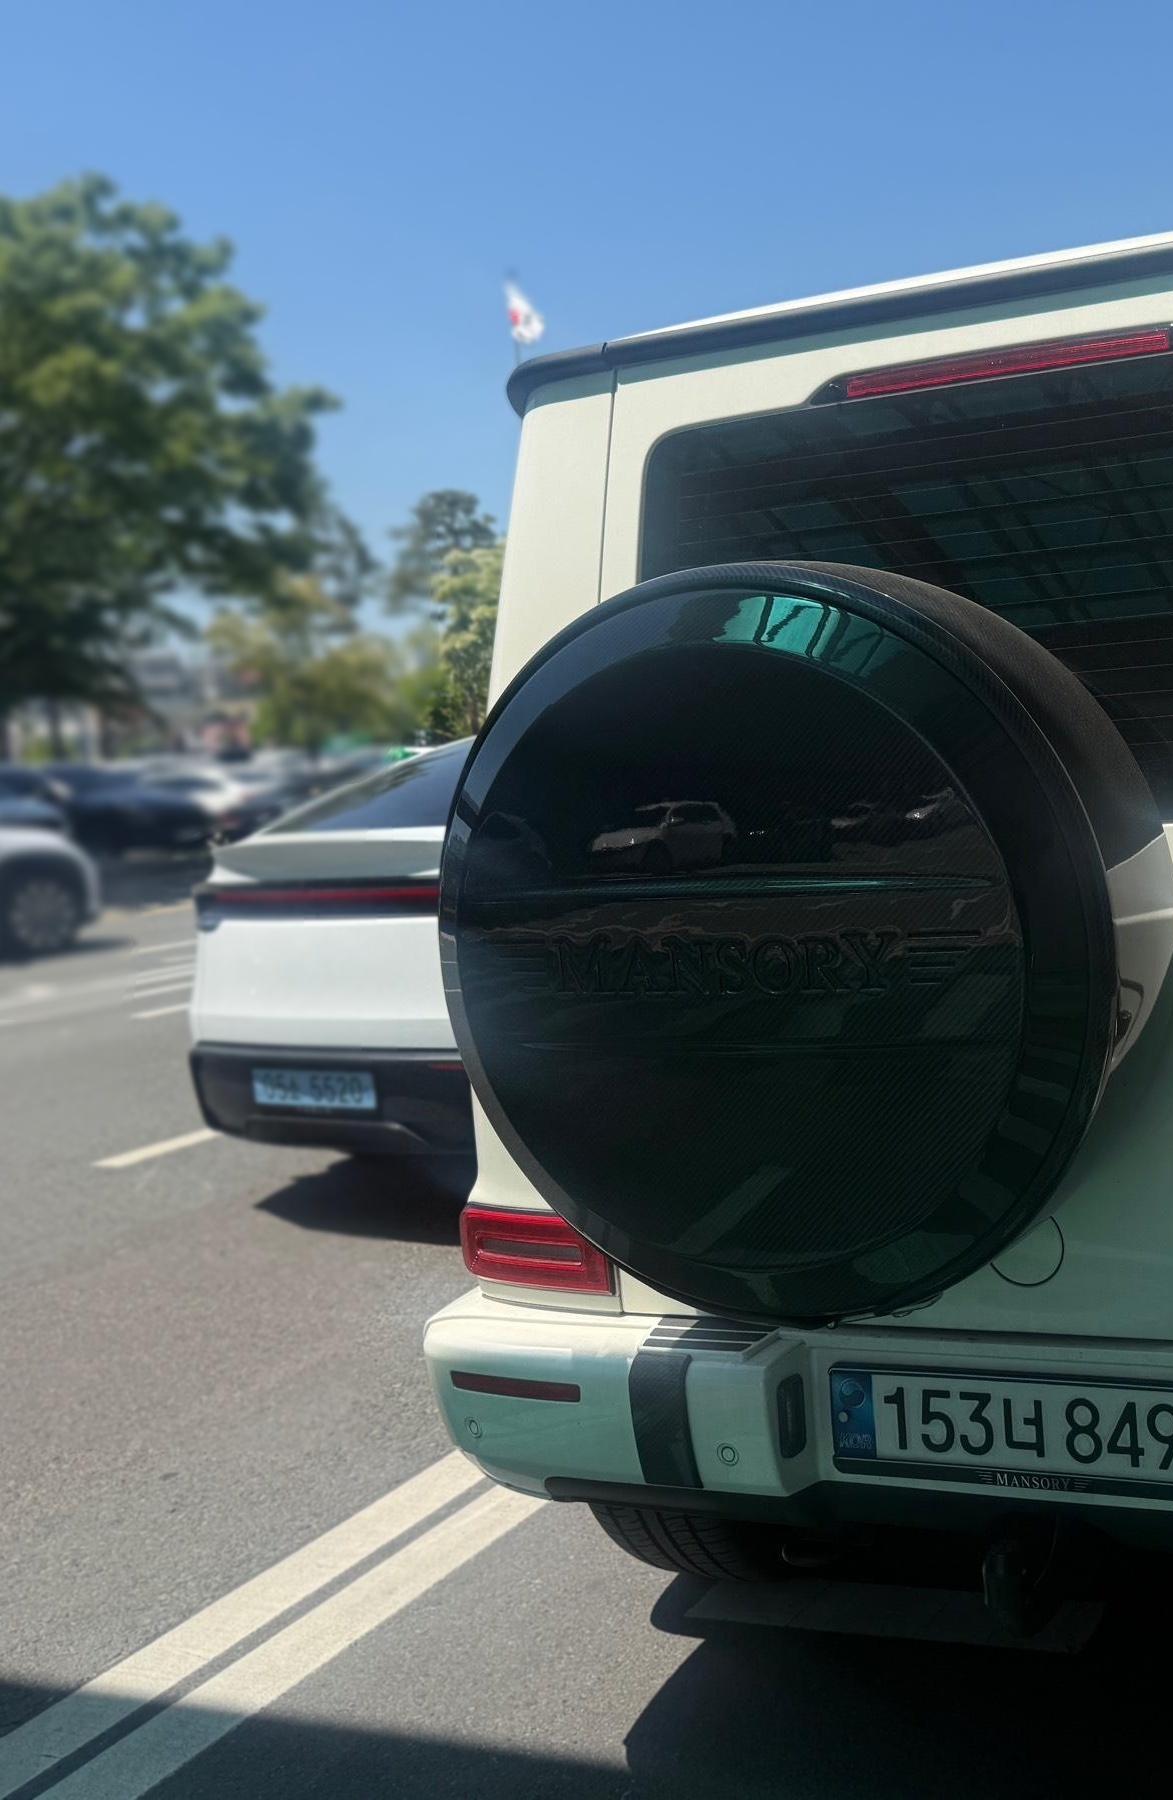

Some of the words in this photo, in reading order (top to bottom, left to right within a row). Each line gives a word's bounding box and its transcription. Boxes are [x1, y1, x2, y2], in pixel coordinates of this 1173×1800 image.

[550, 927, 899, 996] MANSORY
[840, 1432, 872, 1449] KOR
[883, 1387, 1046, 1458] 153너
[996, 1472, 1071, 1491] MANSORY
